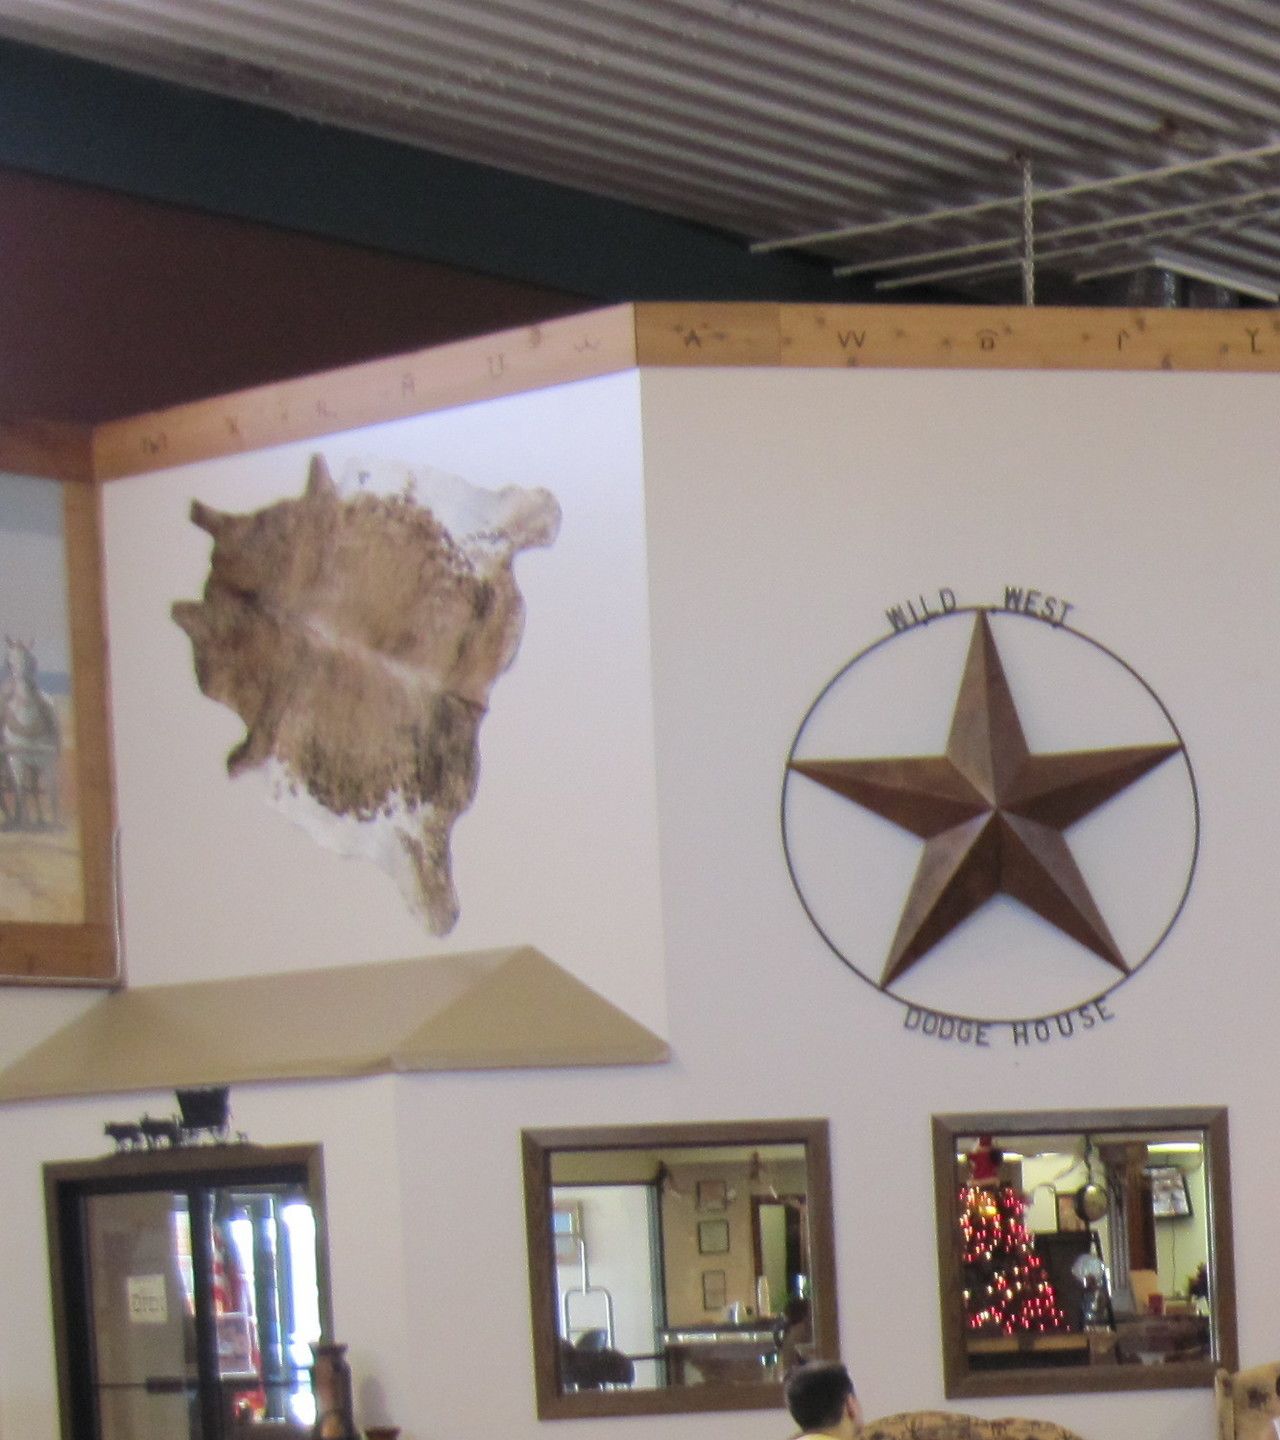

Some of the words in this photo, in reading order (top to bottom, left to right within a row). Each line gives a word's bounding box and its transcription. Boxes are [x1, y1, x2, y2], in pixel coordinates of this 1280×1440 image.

[885, 587, 957, 633] WILD
[1004, 585, 1074, 626] WEST
[904, 1005, 991, 1047] DODGE
[1012, 995, 1115, 1047] HOUSE
